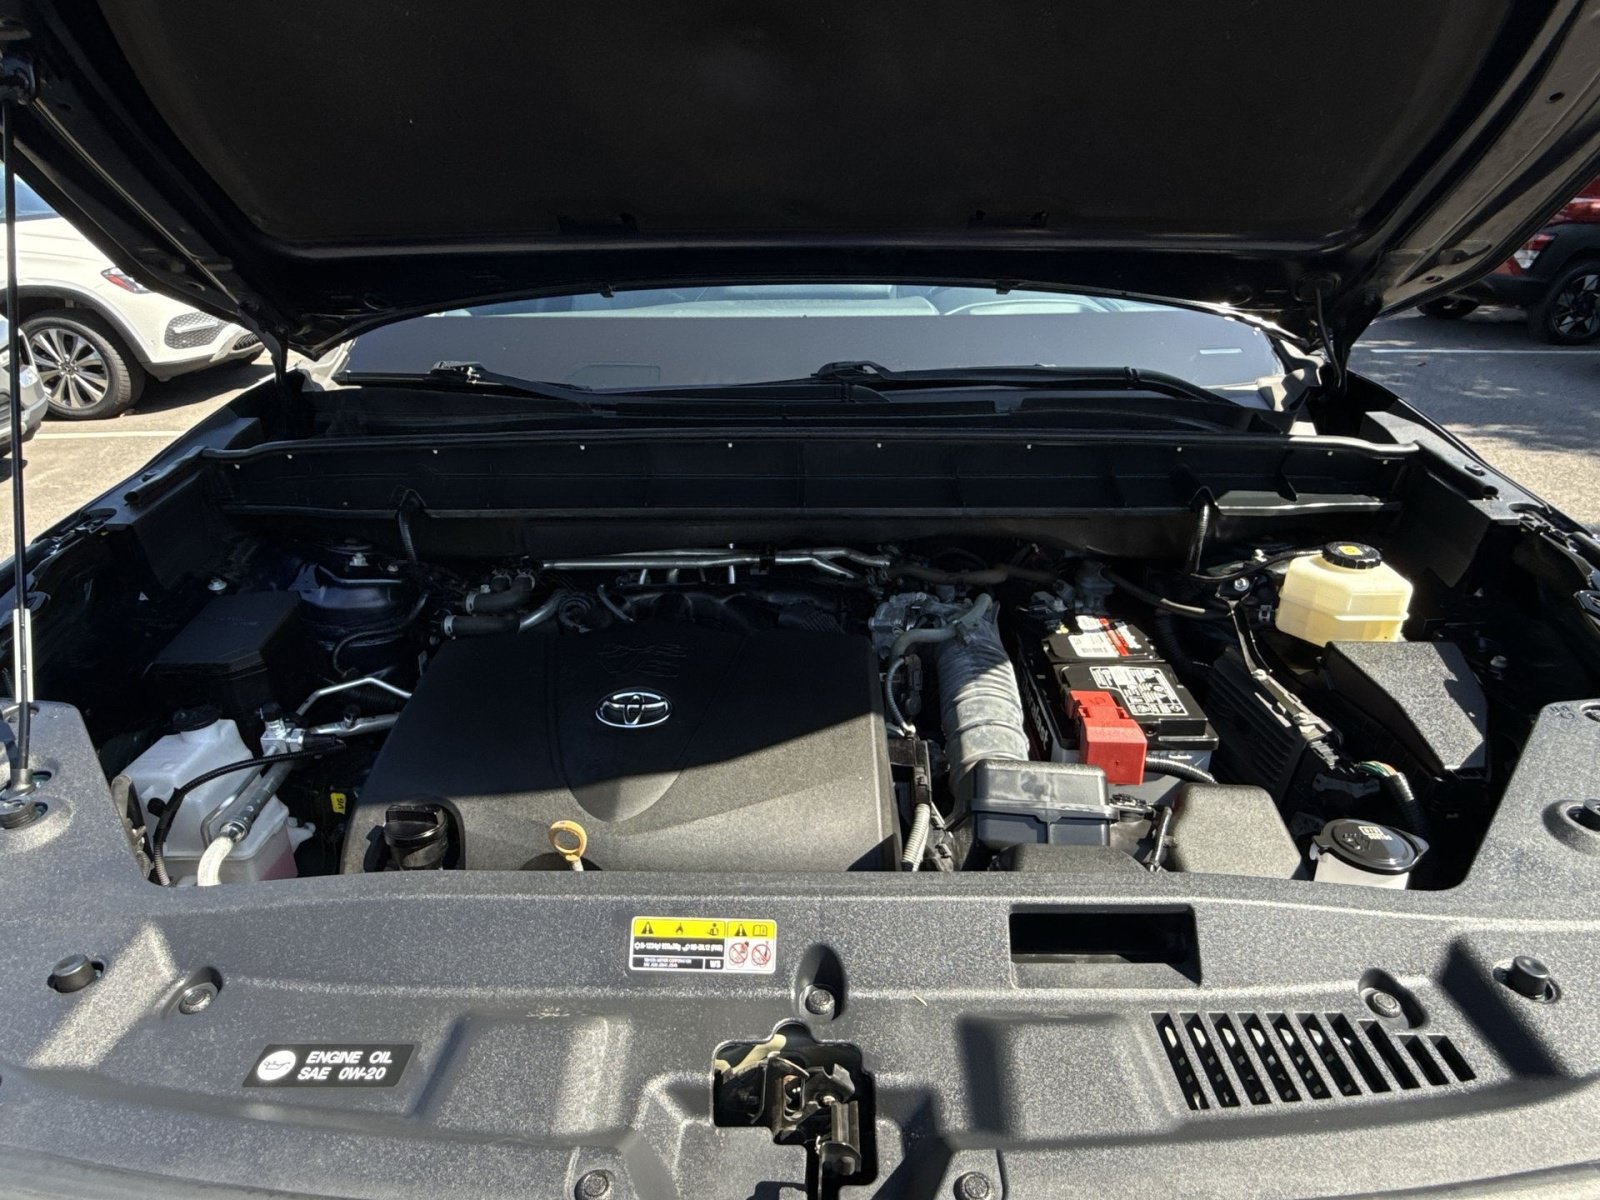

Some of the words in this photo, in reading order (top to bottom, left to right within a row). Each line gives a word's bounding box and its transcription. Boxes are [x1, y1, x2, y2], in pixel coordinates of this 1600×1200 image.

[305, 1051, 364, 1064] ENGINE
[369, 1051, 393, 1064] OIL
[297, 1067, 332, 1080] SAE
[338, 1067, 387, 1080] 0W-20
